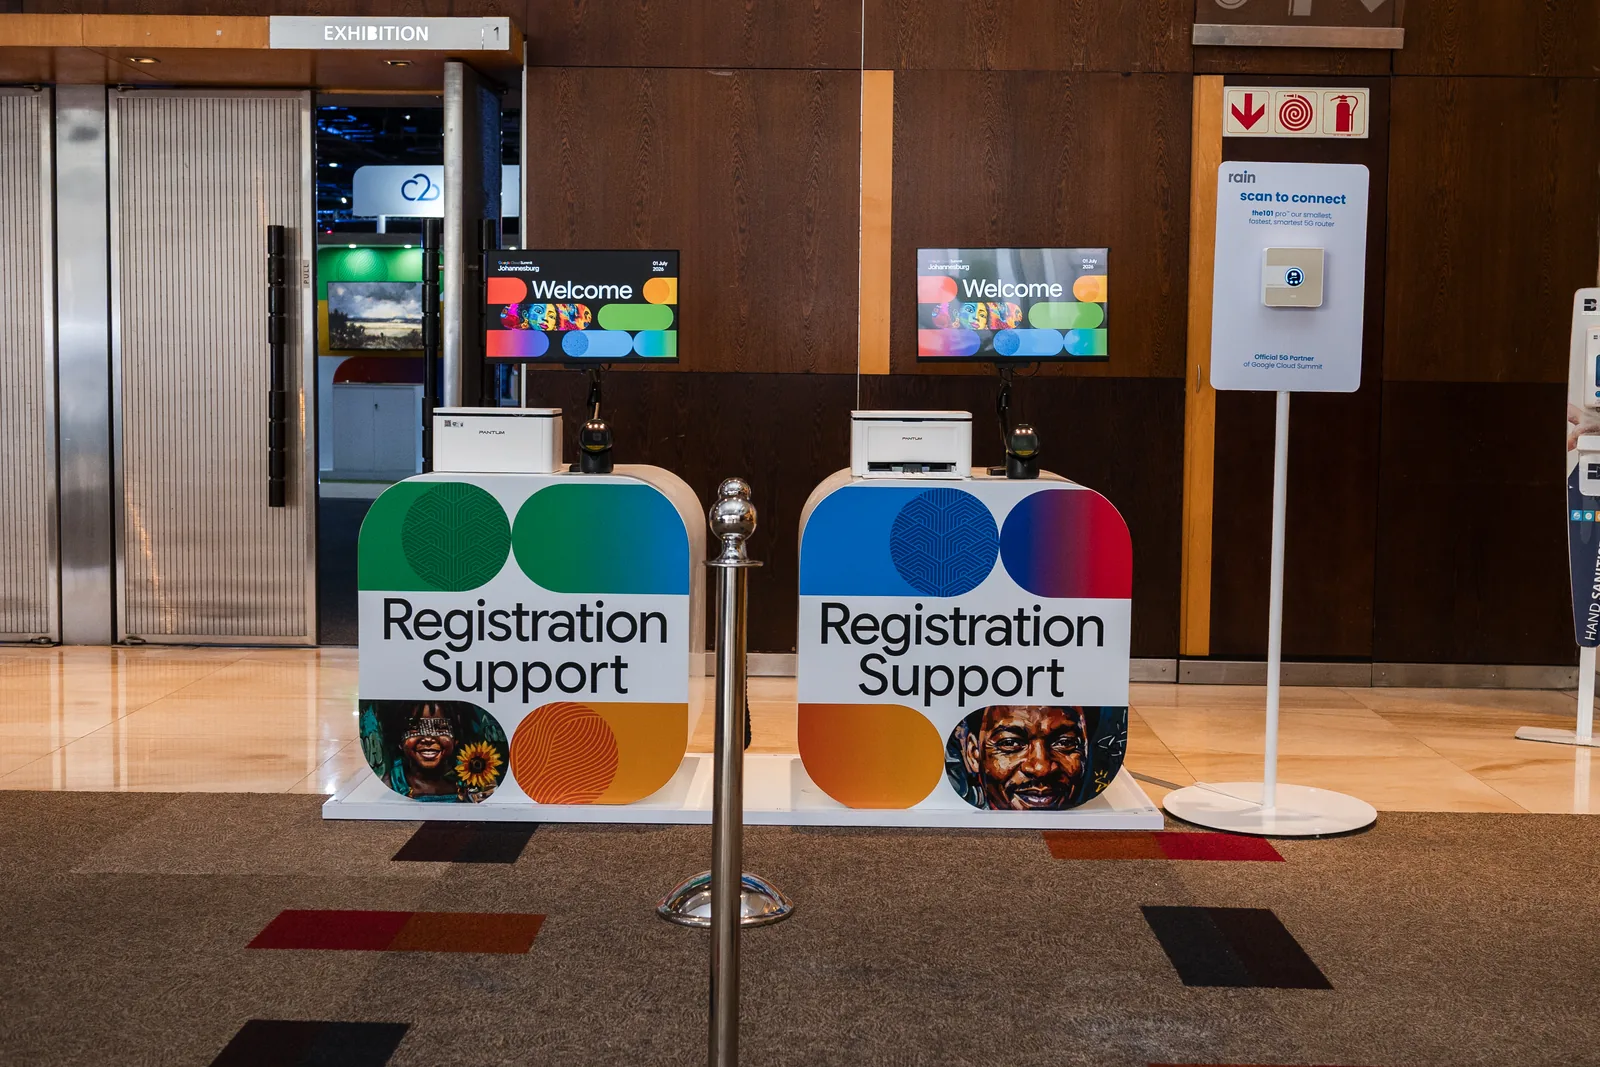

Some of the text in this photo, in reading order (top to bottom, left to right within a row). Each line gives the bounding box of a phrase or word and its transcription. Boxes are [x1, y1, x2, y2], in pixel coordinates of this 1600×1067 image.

[324, 25, 500, 41] EXHIBITION 1
[1228, 170, 1256, 184] rain
[1240, 191, 1347, 205] scan to connect
[1248, 218, 1272, 226] fastest,
[1251, 209, 1274, 217] the101
[1303, 212, 1333, 220] smallest,
[497, 265, 540, 273] Johannesburg
[927, 263, 970, 271] Johannesburg
[531, 280, 633, 300] Welcome
[962, 279, 1063, 298] Welcome
[1254, 353, 1278, 361] Official
[1251, 361, 1275, 370] Google
[1296, 362, 1323, 370] Summit
[383, 597, 668, 653] Registration
[820, 602, 1104, 656] Registration
[1584, 602, 1600, 641] HAND
[421, 648, 629, 704] Support
[858, 653, 1064, 707] Support
